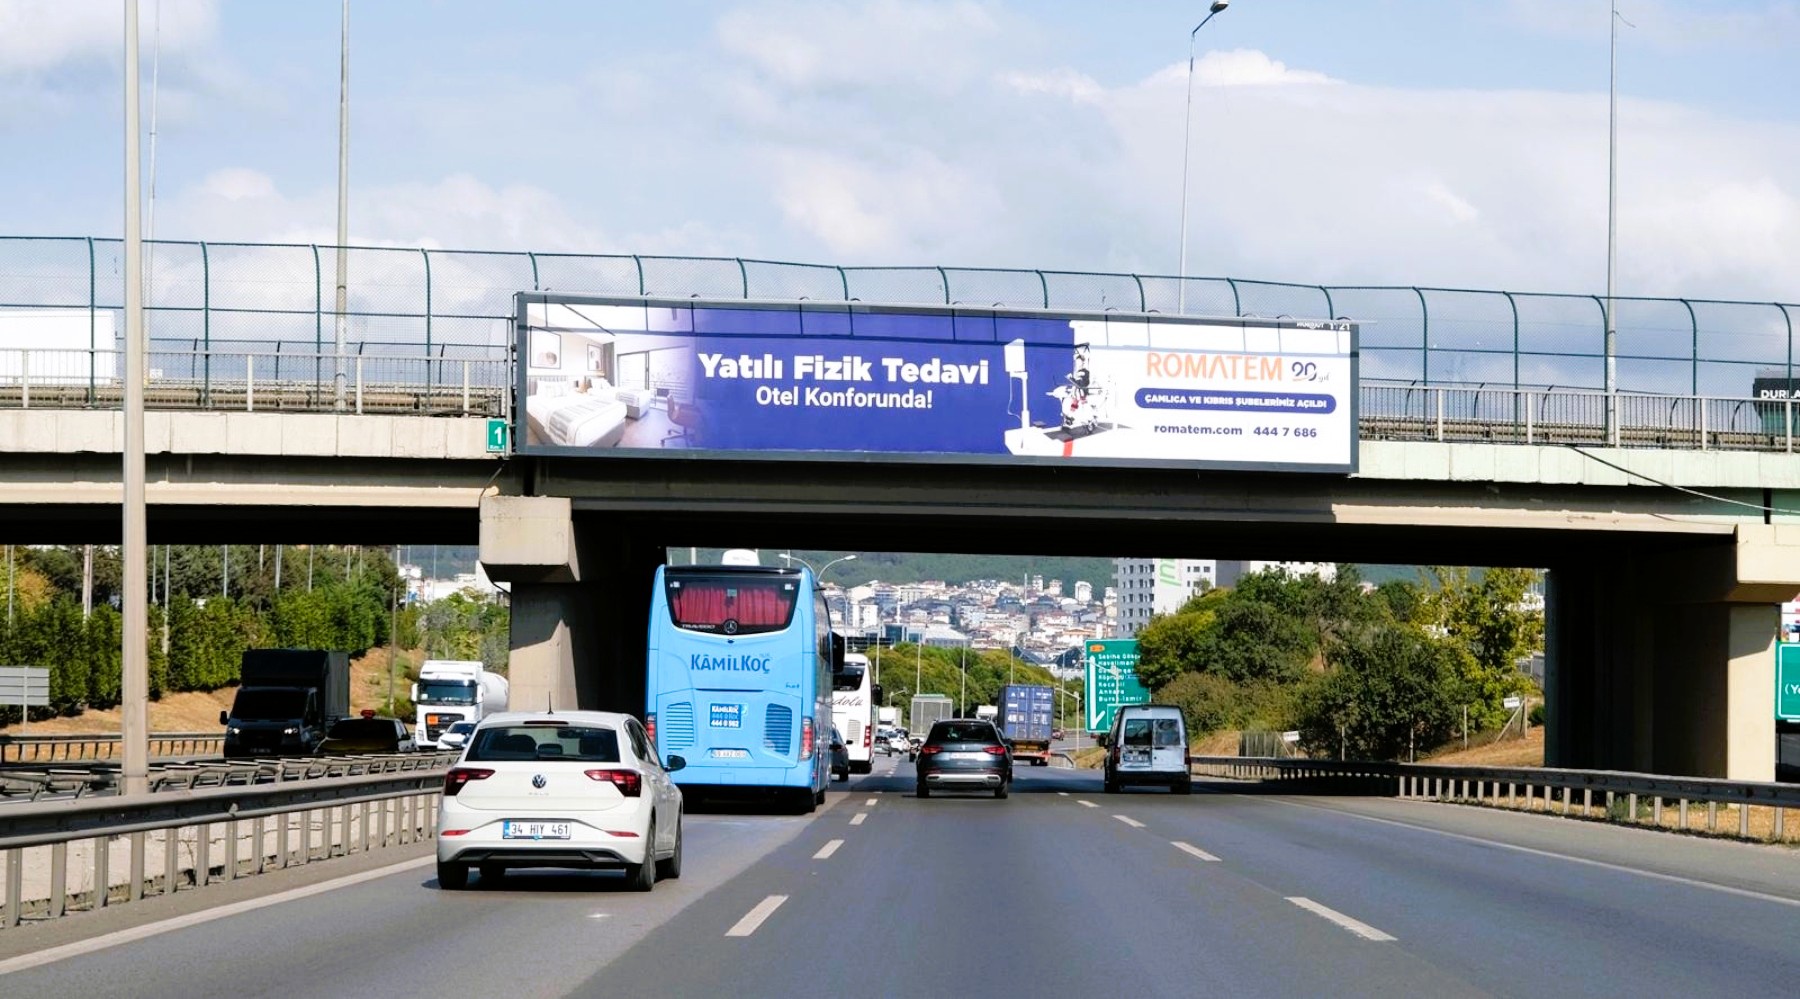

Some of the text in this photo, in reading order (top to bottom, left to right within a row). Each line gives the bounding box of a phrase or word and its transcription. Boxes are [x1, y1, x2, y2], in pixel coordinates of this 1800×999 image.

[698, 353, 989, 385] Yatılı Fizik Tedavi
[1146, 352, 1282, 381] ROMATEM
[756, 386, 933, 409] Otel Konforunda!
[1144, 394, 1327, 409] ÇAMLICA VE KIBRIS ŞUBELERİMİZ AÇILDI
[494, 426, 502, 445] 1
[1154, 424, 1317, 438] romatem.com 444 7 686
[511, 824, 523, 834] 34
[551, 824, 569, 835] 461
